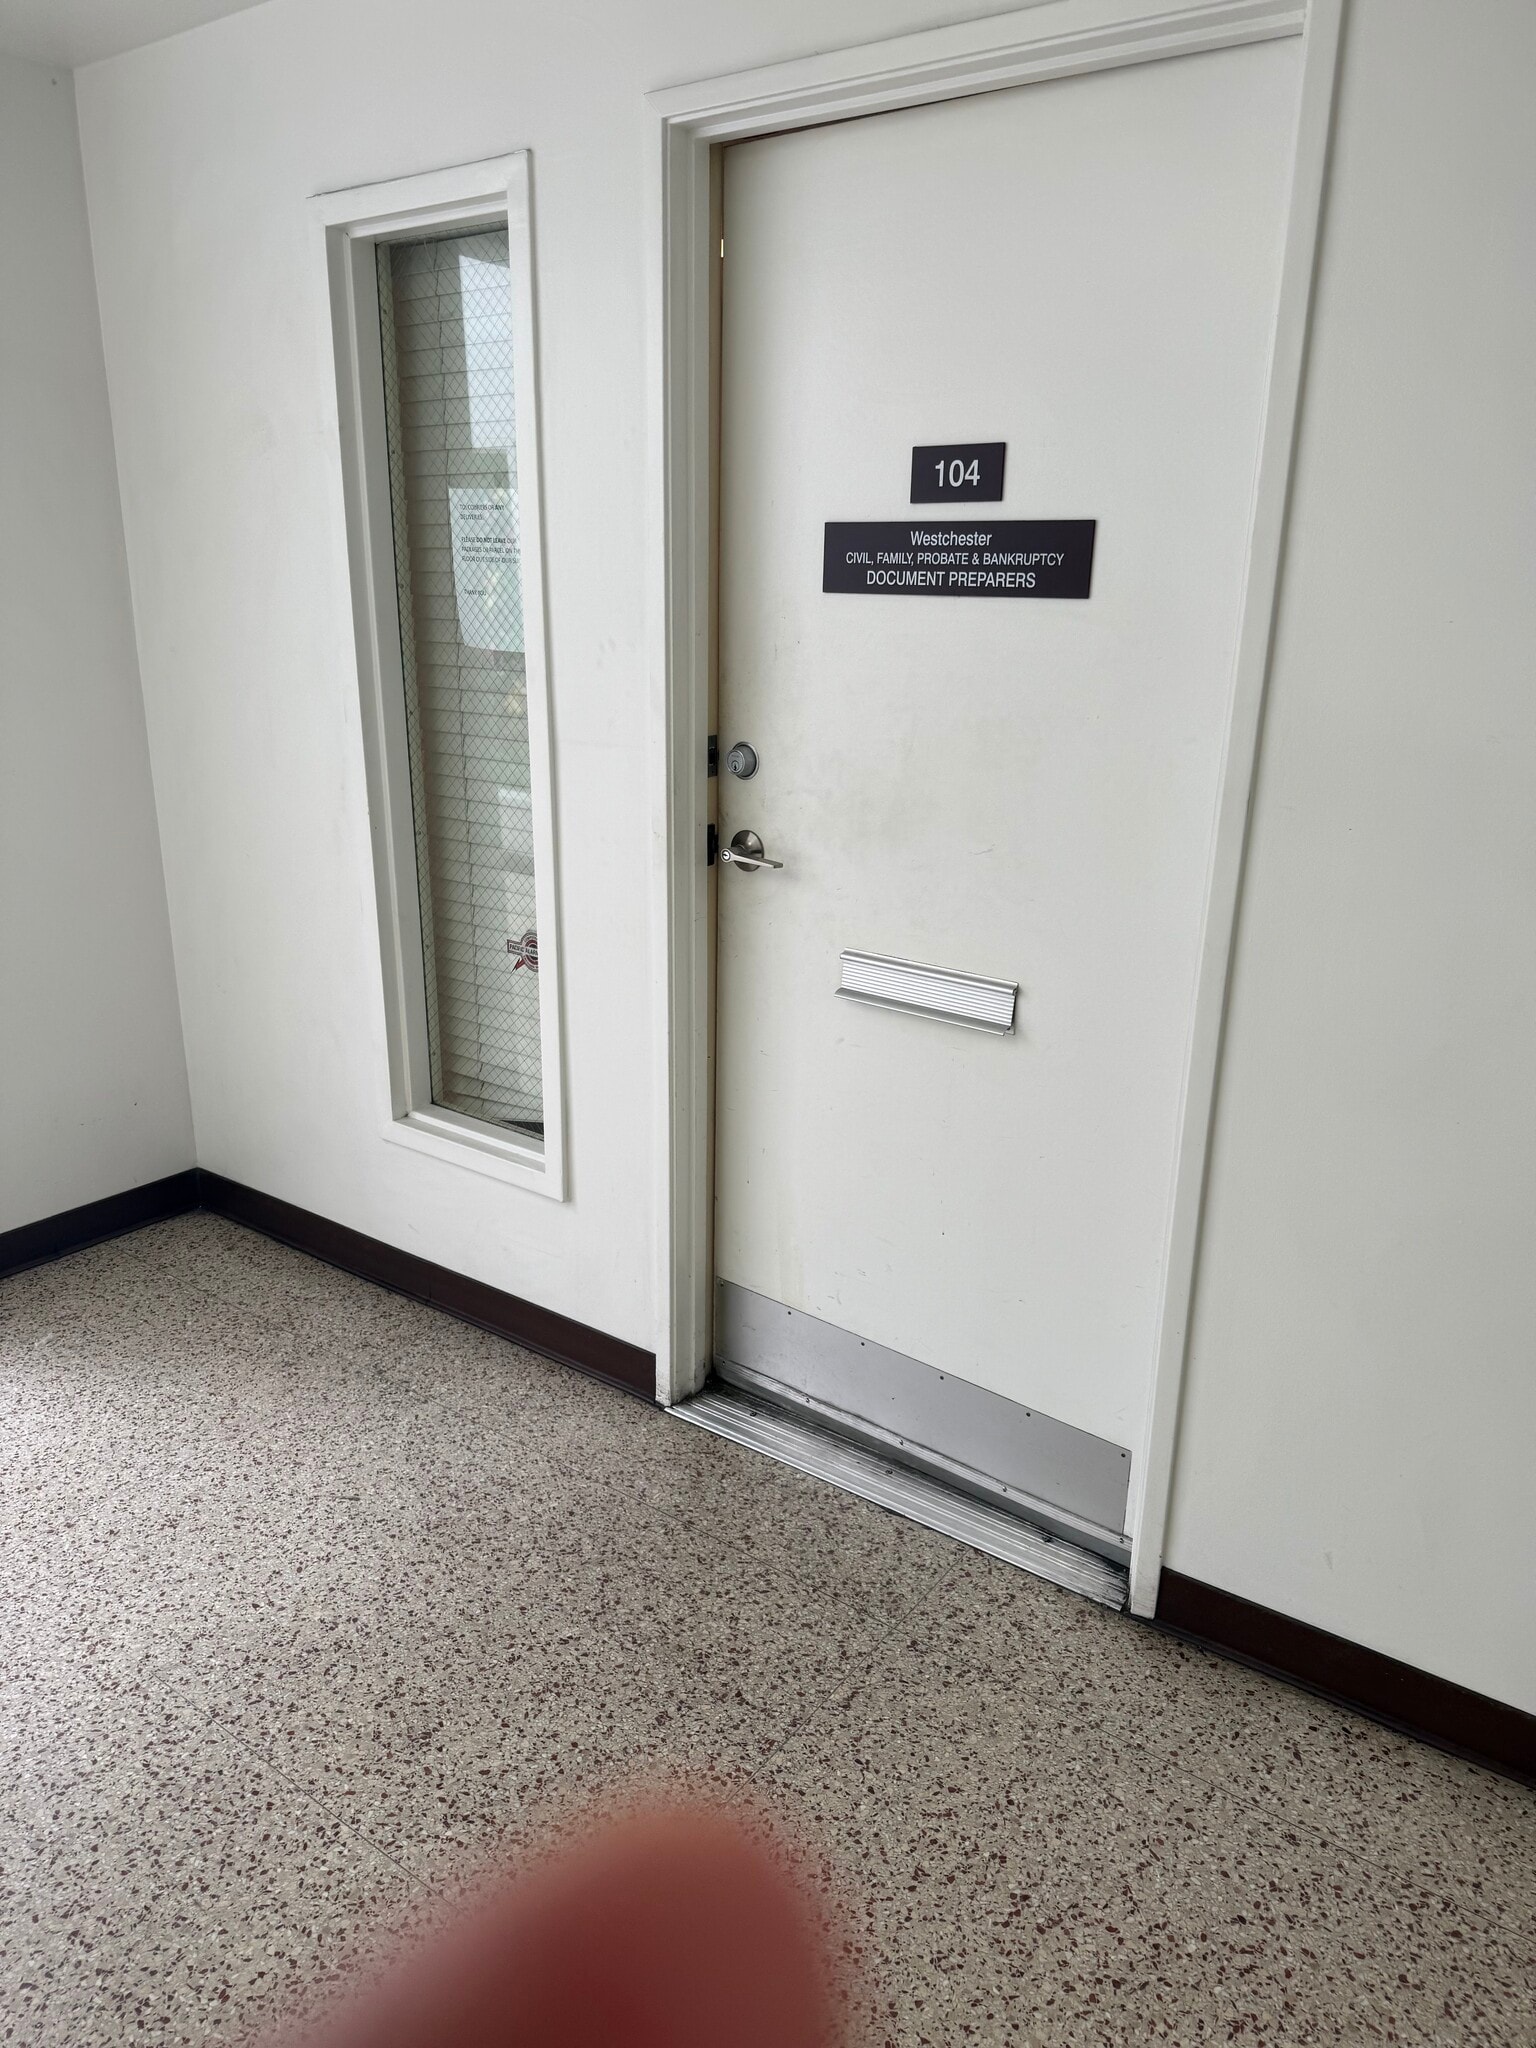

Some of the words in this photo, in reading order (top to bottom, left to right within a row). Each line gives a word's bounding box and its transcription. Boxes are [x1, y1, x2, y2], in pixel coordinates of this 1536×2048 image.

[935, 459, 980, 488] 104
[911, 531, 992, 546] Westchester
[846, 552, 874, 565] CIVIL,
[876, 552, 914, 566] FAMILY,
[917, 553, 969, 565] PROBATE
[972, 553, 980, 565] &
[983, 553, 1064, 566] BANKRUPTCY
[867, 571, 946, 586] DOCUMENT
[949, 572, 1036, 588] PREPARERS
